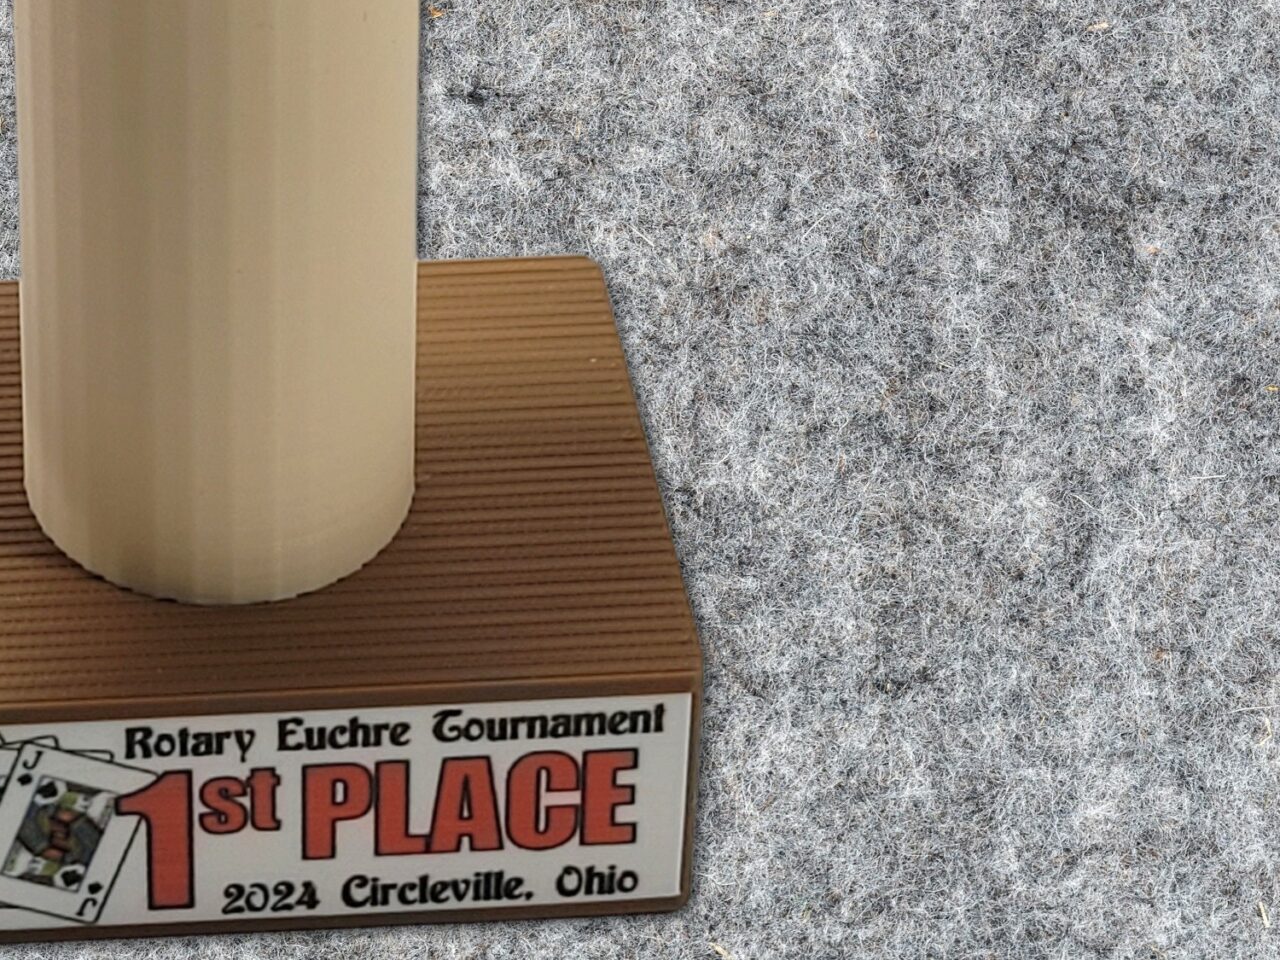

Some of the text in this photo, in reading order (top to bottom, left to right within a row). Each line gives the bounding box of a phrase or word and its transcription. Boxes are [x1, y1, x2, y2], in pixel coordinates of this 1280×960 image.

[124, 703, 665, 762] Rotary Euchre Tournament
[22, 750, 43, 770] J
[115, 747, 638, 910] 1st PLACE
[221, 880, 320, 915] 2024
[556, 865, 638, 897] Ohio
